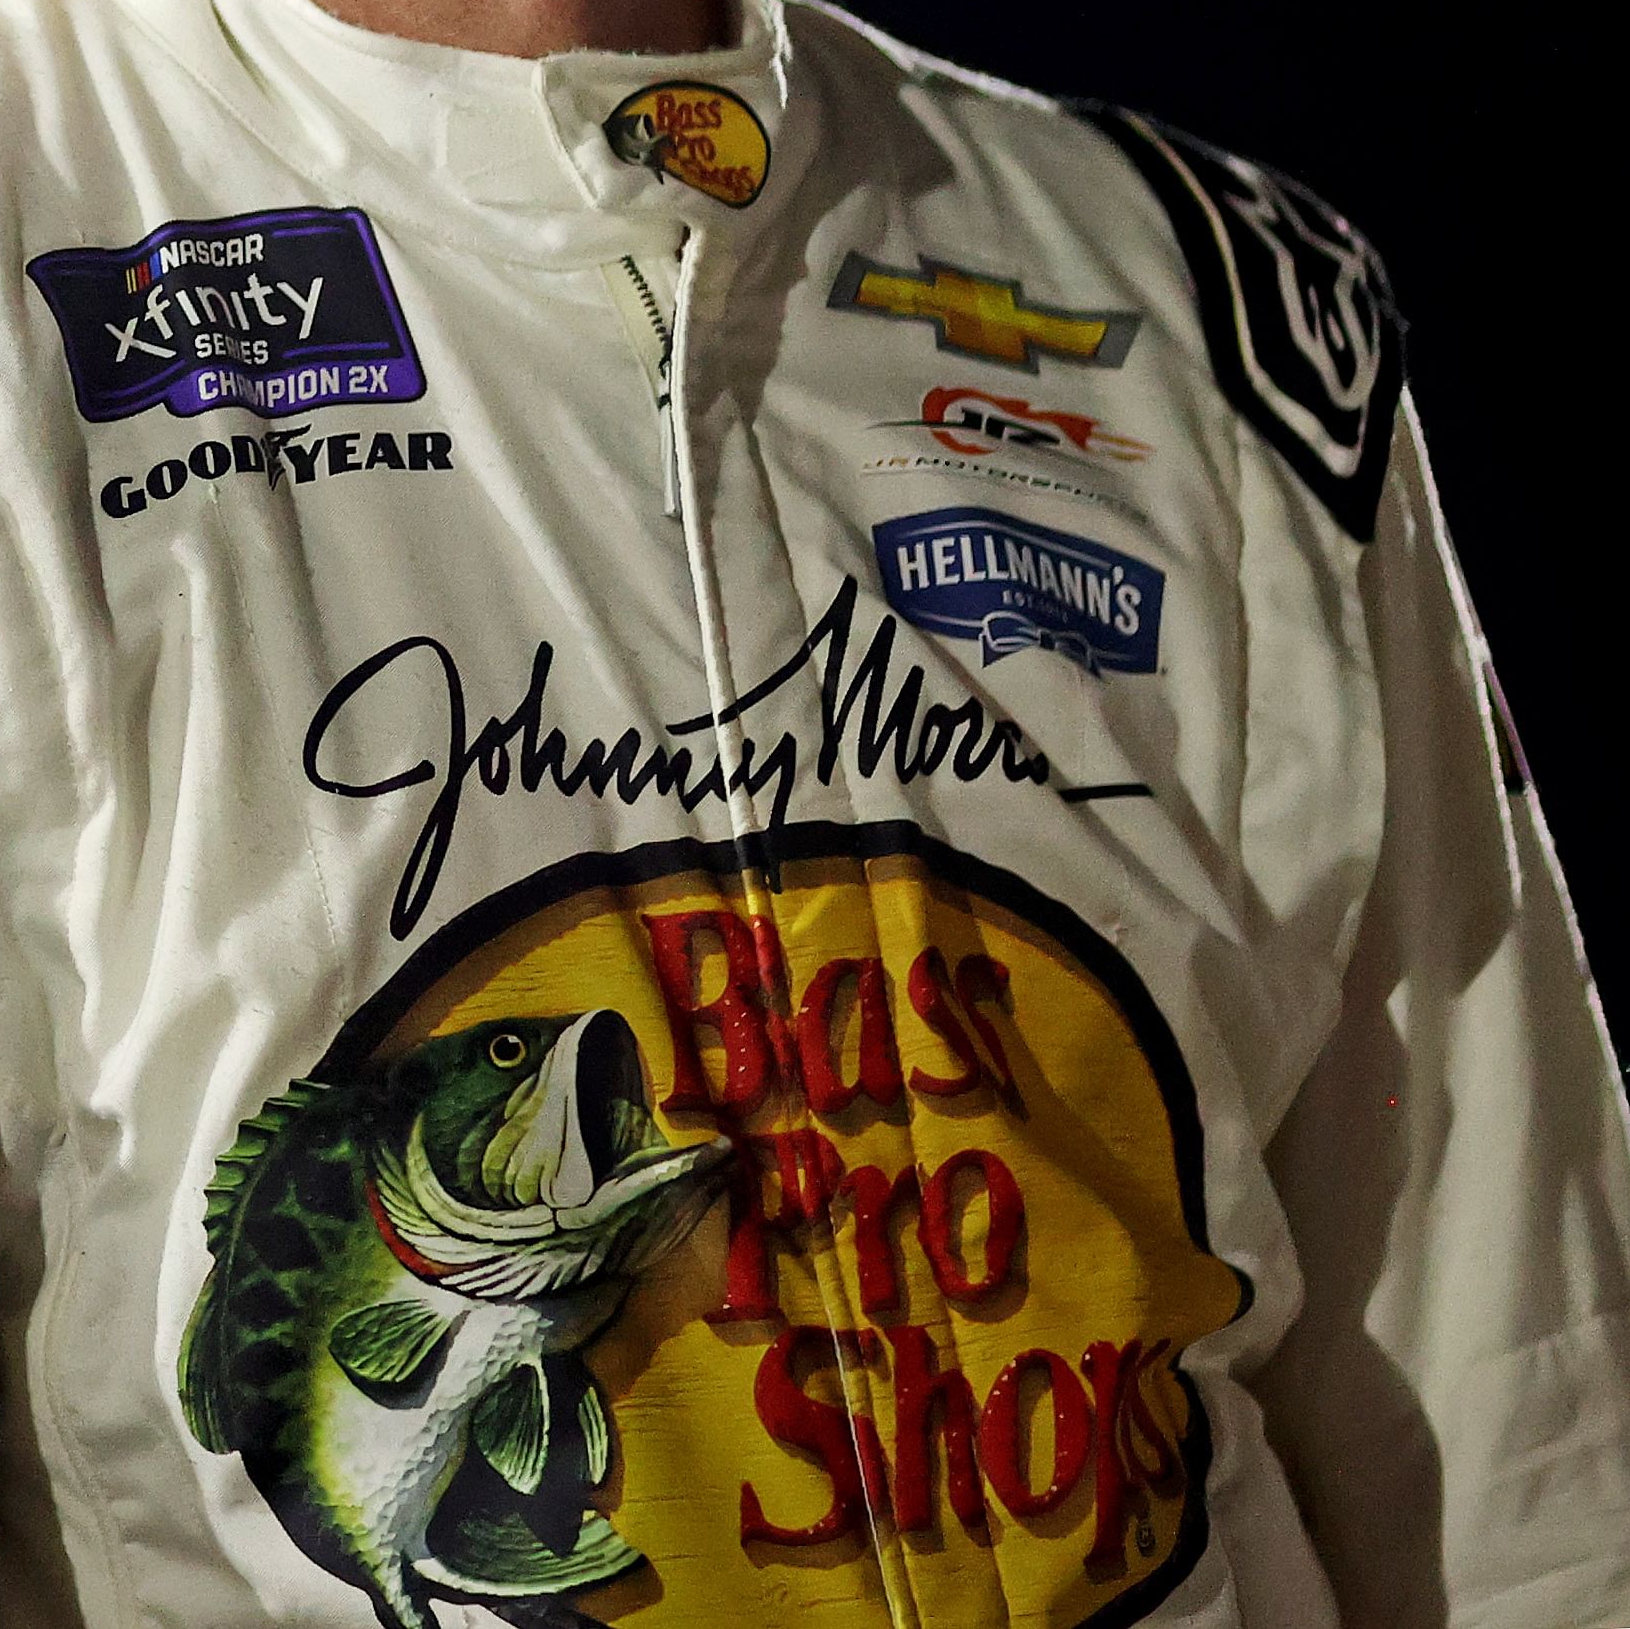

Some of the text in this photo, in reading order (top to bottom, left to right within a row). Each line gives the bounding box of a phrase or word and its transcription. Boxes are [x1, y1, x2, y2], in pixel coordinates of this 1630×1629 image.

[655, 93, 722, 132] Bass
[156, 232, 266, 274] NASCAR
[104, 271, 324, 363] xfinity
[194, 333, 270, 365] SERIES
[197, 365, 389, 408] CHAMPION 2X
[100, 428, 454, 520] GOODYEAR
[896, 533, 1143, 637] HELLMANN'S
[702, 1127, 1026, 1325] Pro
[742, 1323, 1175, 1575] Shops
